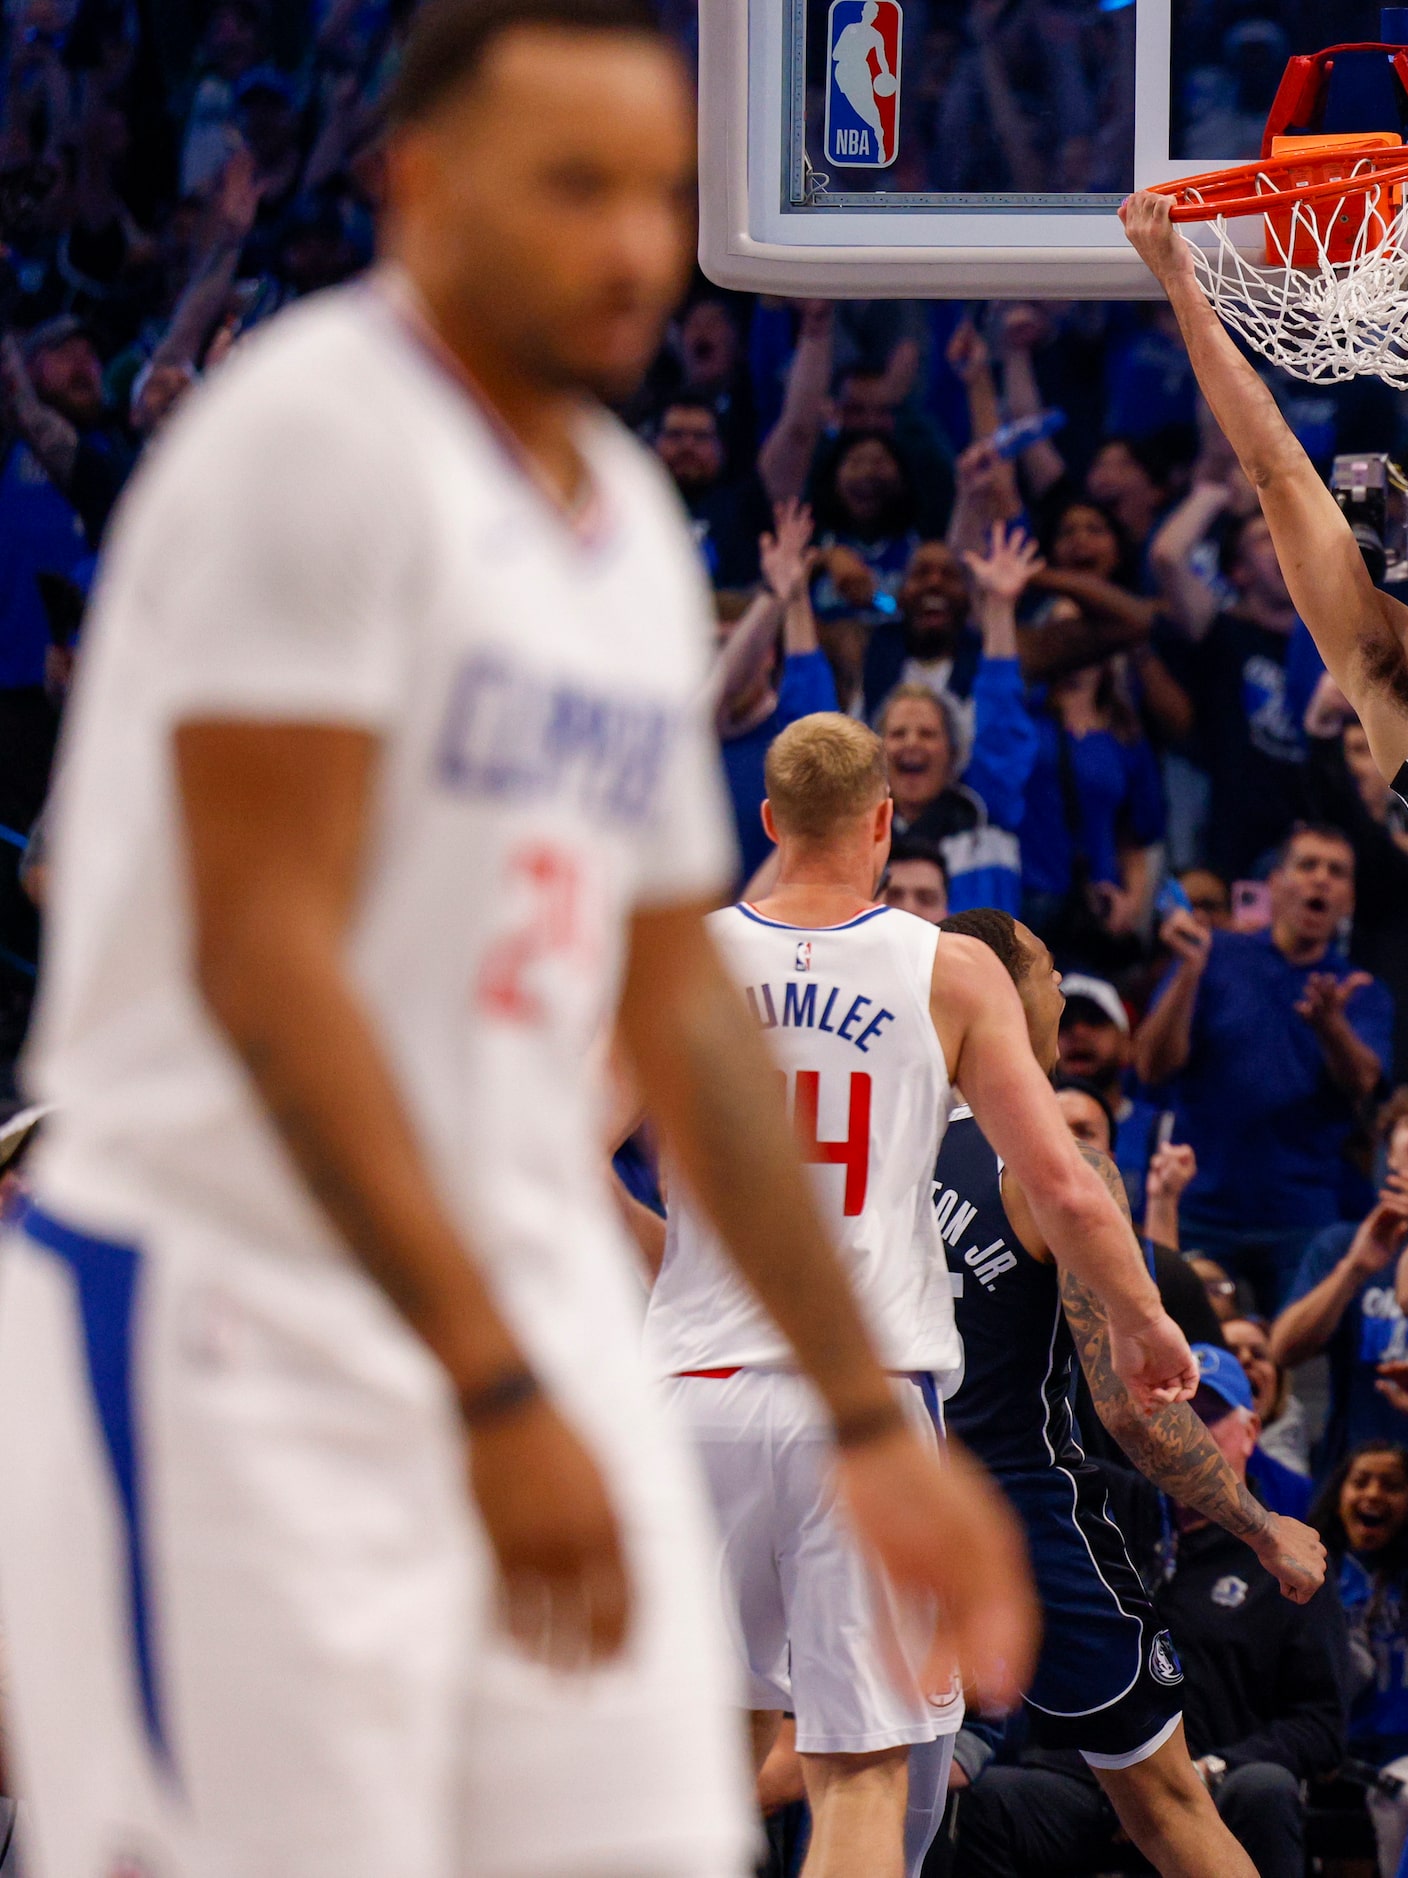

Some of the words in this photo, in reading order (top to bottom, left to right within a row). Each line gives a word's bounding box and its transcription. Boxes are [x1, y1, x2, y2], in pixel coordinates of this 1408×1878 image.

[836, 129, 870, 156] NBA
[774, 1069, 872, 1217] 4
[964, 1238, 1018, 1292] JR.
